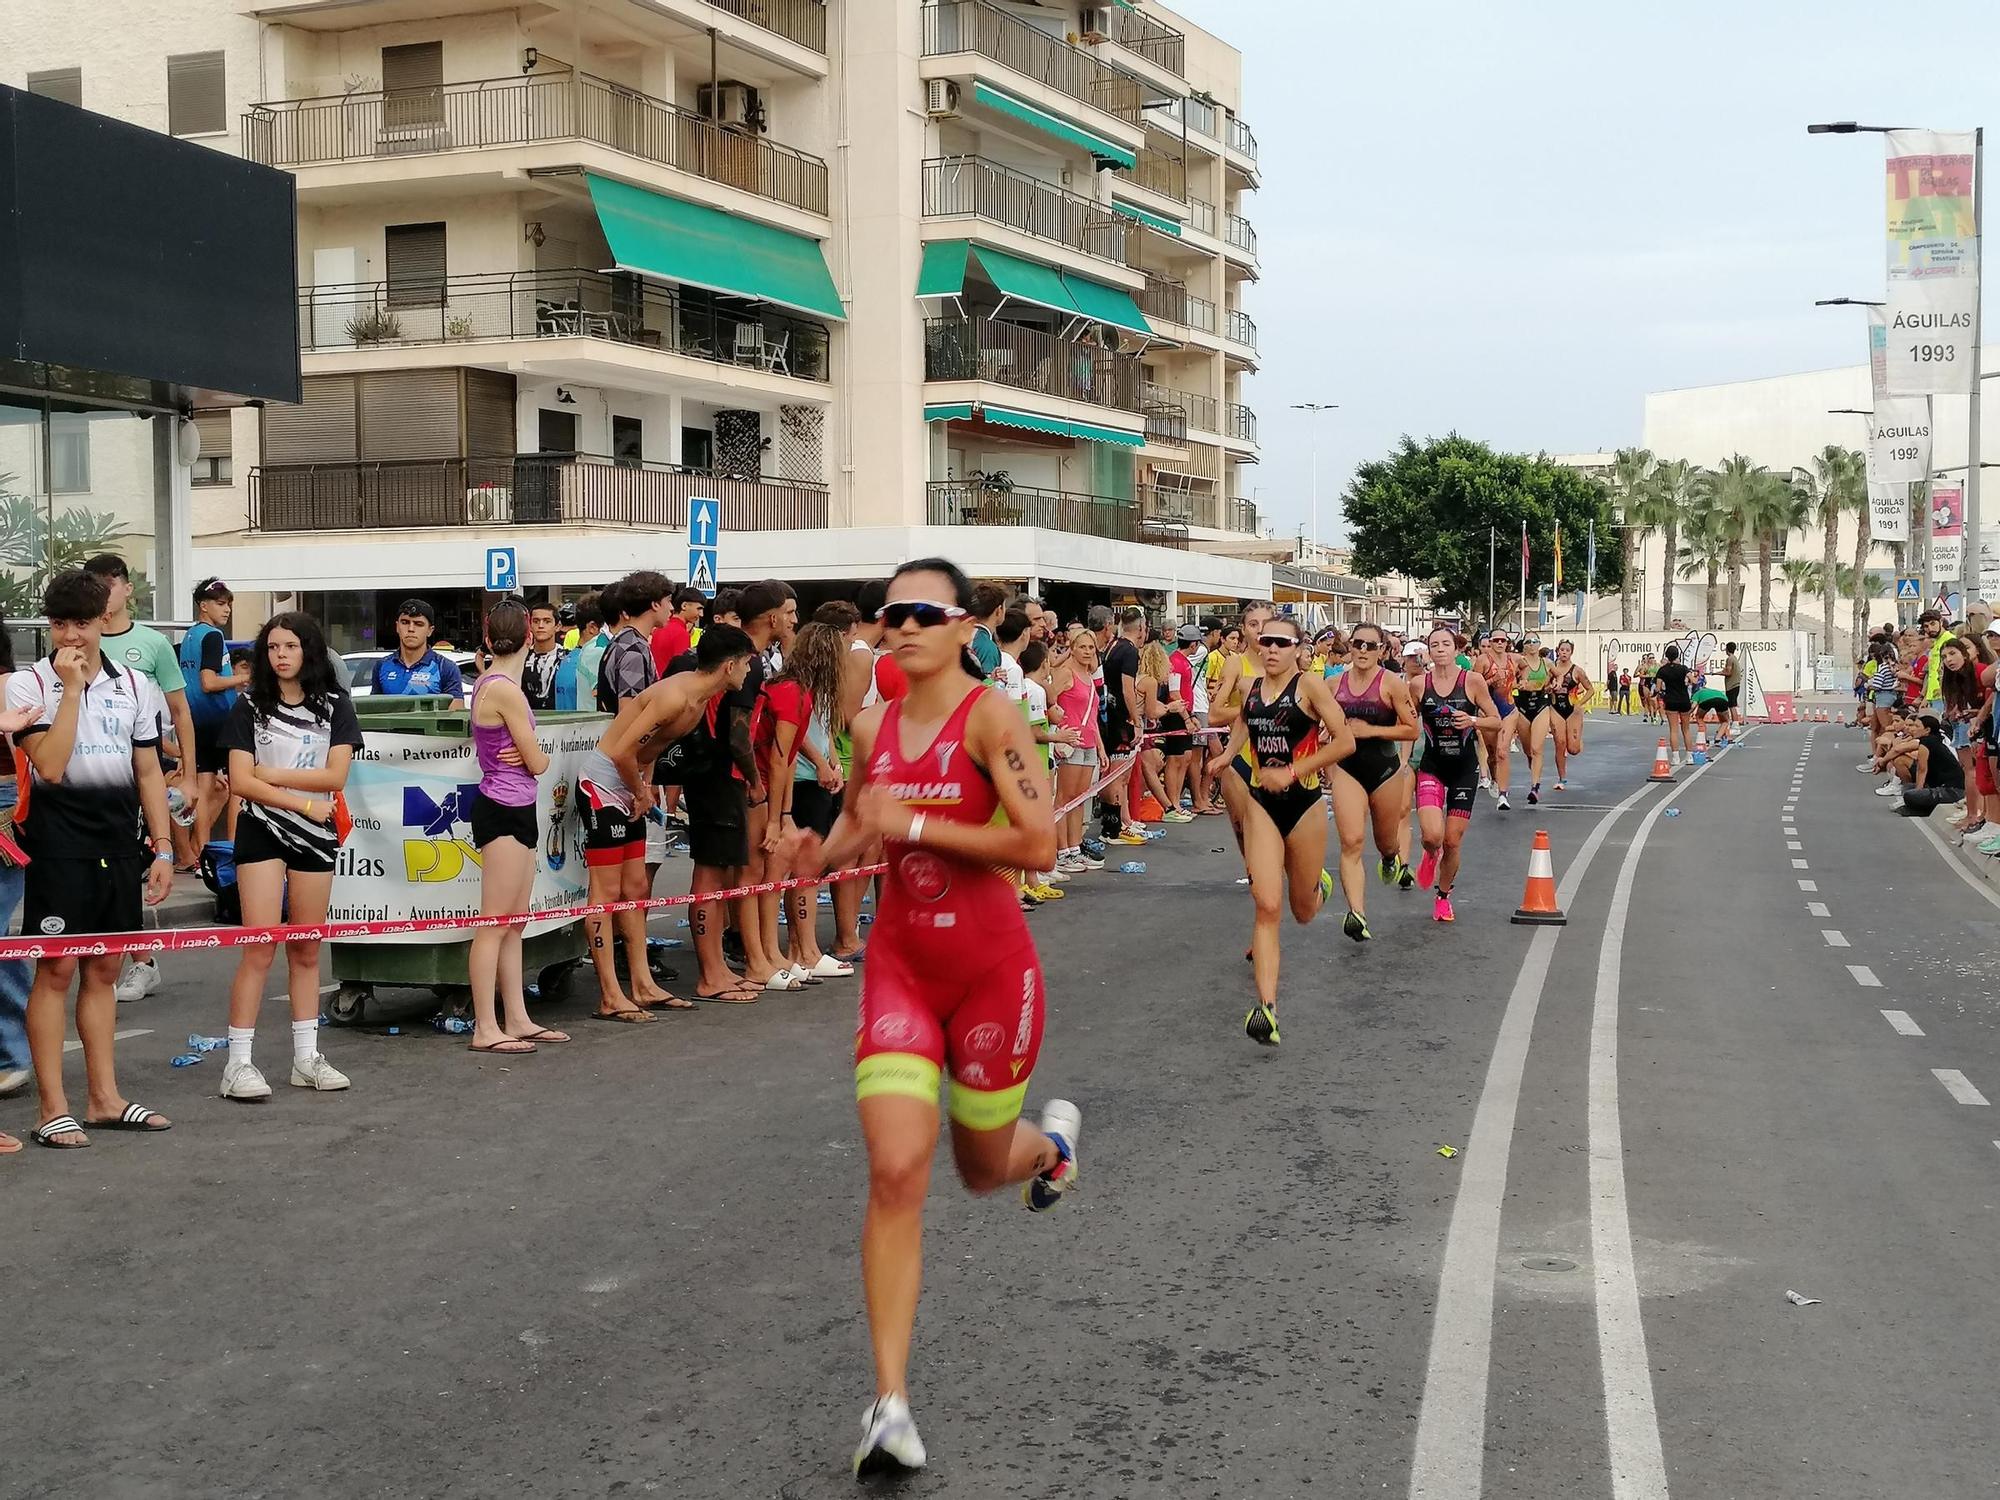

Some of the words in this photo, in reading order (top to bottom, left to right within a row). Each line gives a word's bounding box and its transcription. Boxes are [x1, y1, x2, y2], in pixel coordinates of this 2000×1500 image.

[1892, 311, 1971, 329] ÁGUILAS
[1909, 345, 1955, 363] 1993
[1877, 426, 1929, 440] ÁGUILAS
[1889, 447, 1919, 461] 1992
[491, 551, 511, 587] P
[403, 744, 472, 761] Patronato
[1257, 736, 1290, 754] ACOSTA
